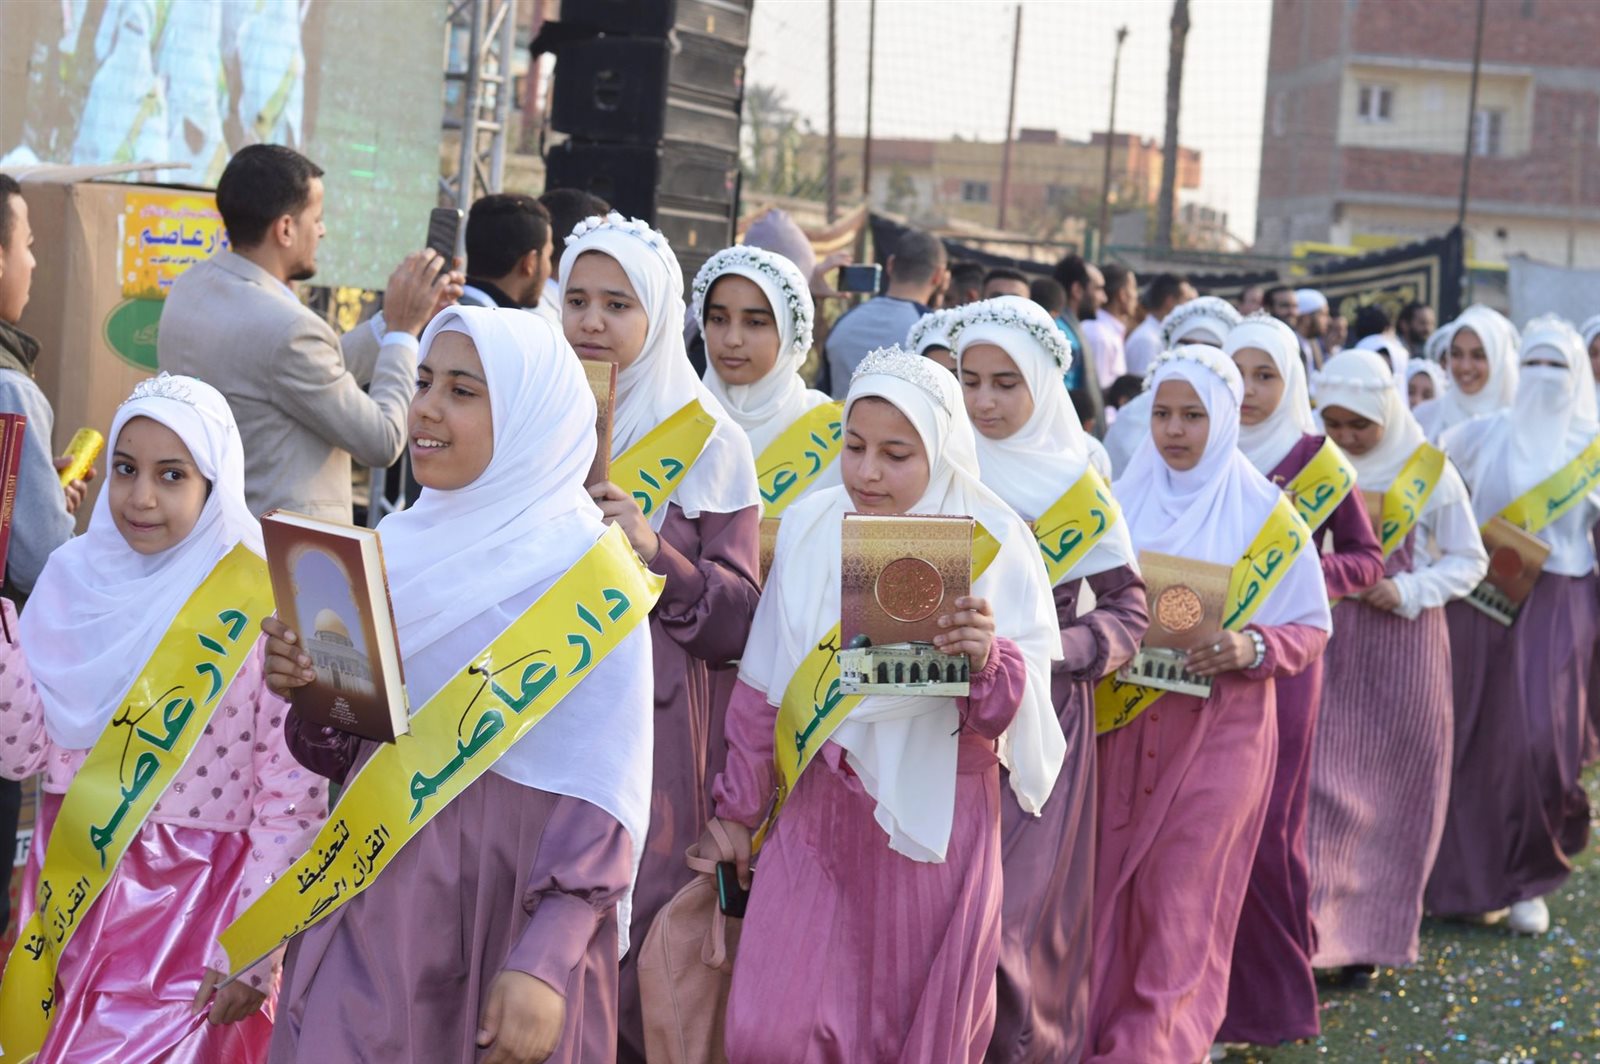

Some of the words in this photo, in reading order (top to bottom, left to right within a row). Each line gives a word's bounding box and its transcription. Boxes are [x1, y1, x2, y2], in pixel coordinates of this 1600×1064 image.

[140, 223, 203, 253] عاصم
[631, 457, 685, 516] دار
[194, 608, 250, 706] دار
[565, 586, 633, 678] دار
[88, 696, 198, 870] عاصم
[407, 660, 559, 825] عاصم
[297, 819, 350, 895] لتحفيظ
